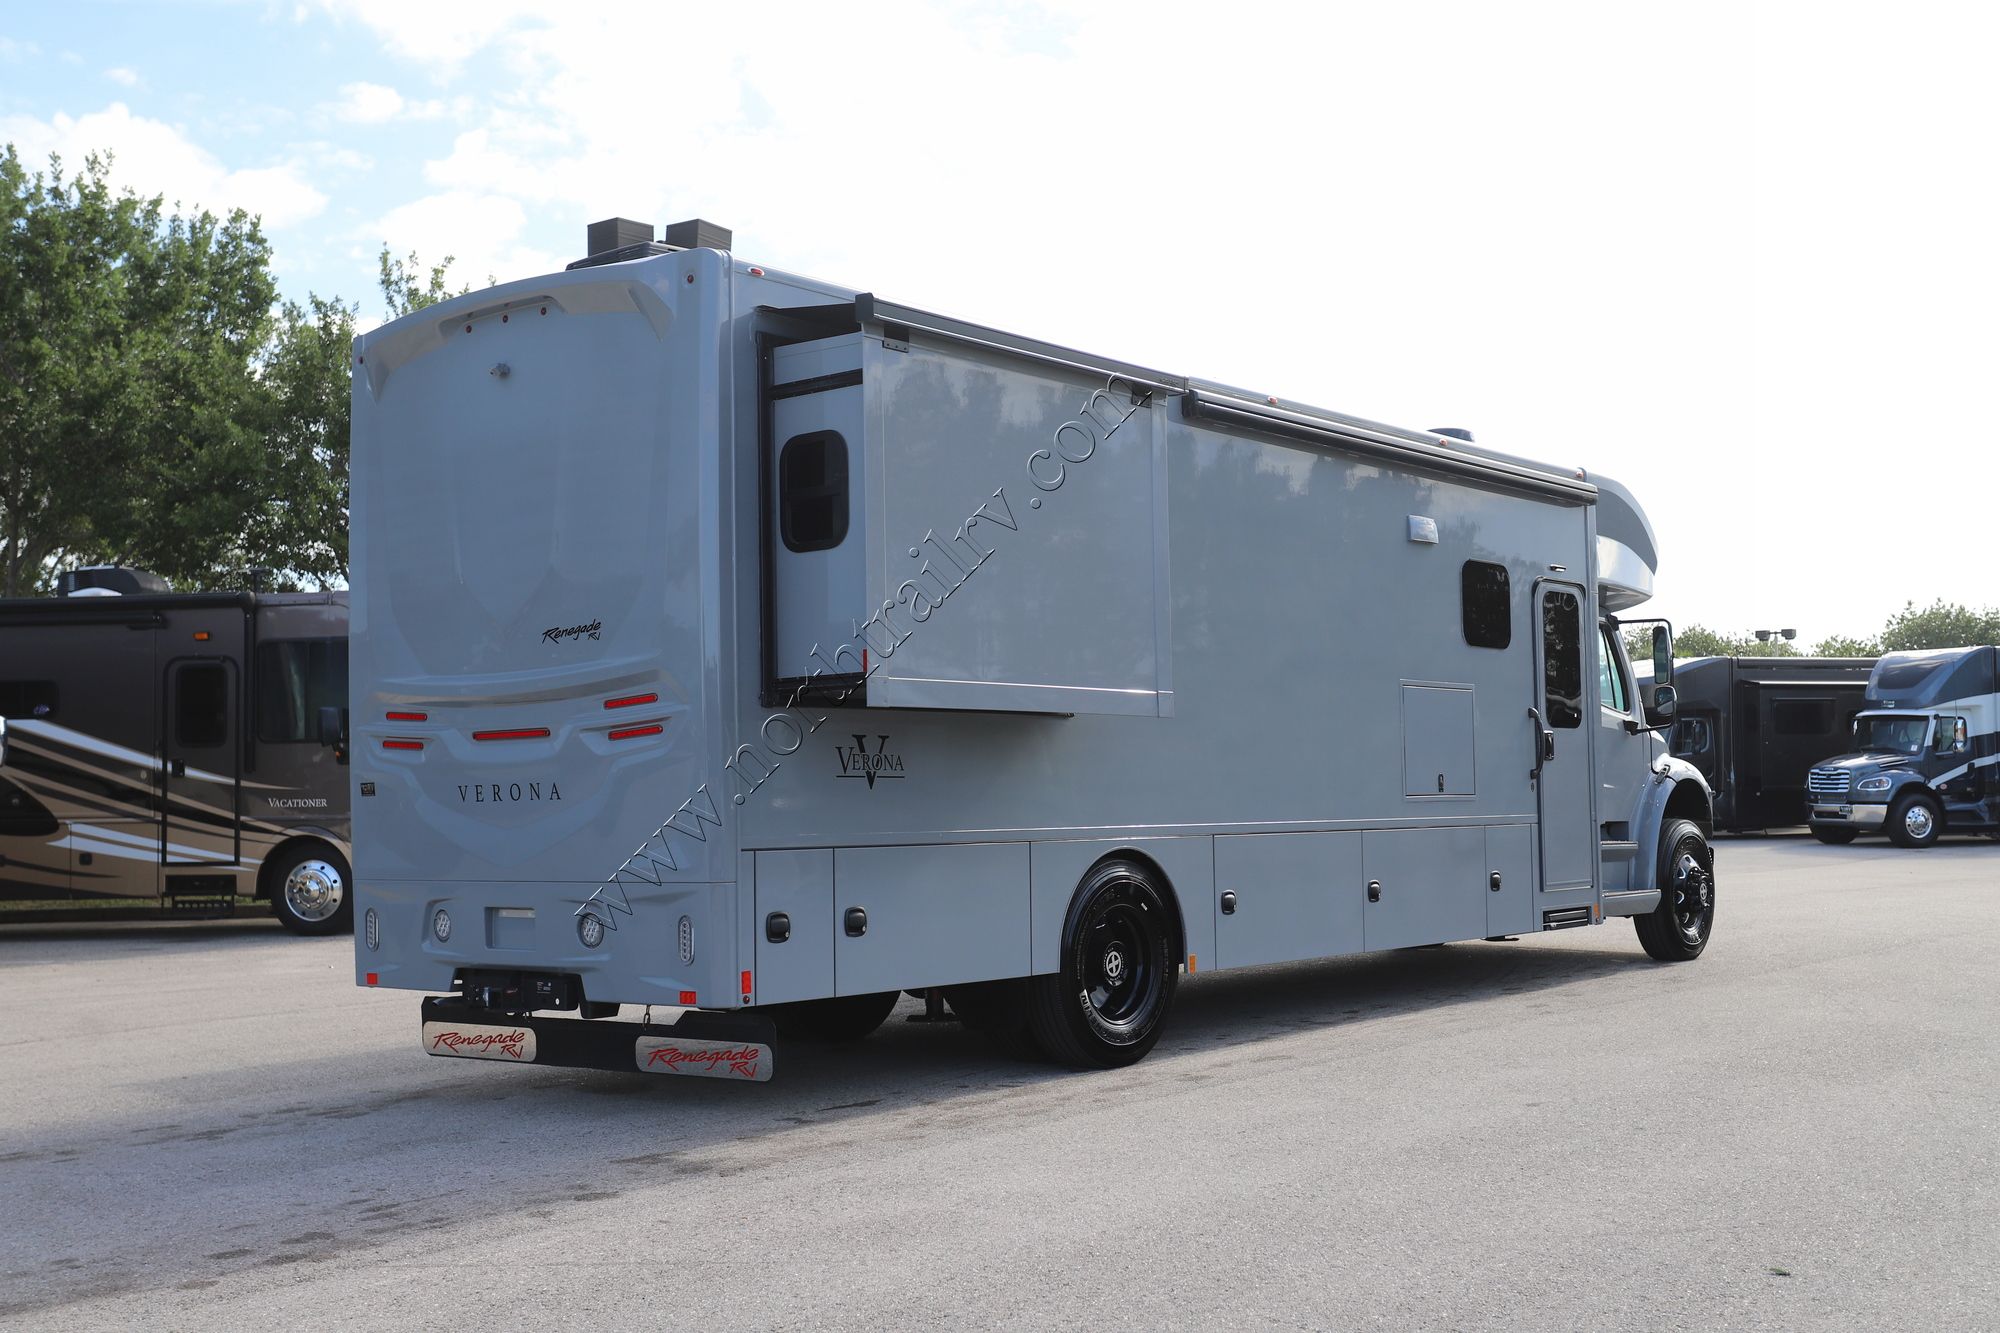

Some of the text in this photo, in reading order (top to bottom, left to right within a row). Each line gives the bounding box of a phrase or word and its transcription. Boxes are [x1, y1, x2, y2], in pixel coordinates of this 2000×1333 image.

[542, 619, 601, 644] Renegade
[588, 632, 601, 641] RV
[835, 746, 905, 774] VERONA
[458, 782, 562, 802] VERONA
[268, 798, 327, 808] VACATIONER
[433, 1029, 525, 1054] Renegade
[500, 1043, 524, 1059] RV
[647, 1045, 759, 1072] Renegade
[729, 1061, 758, 1078] RV
